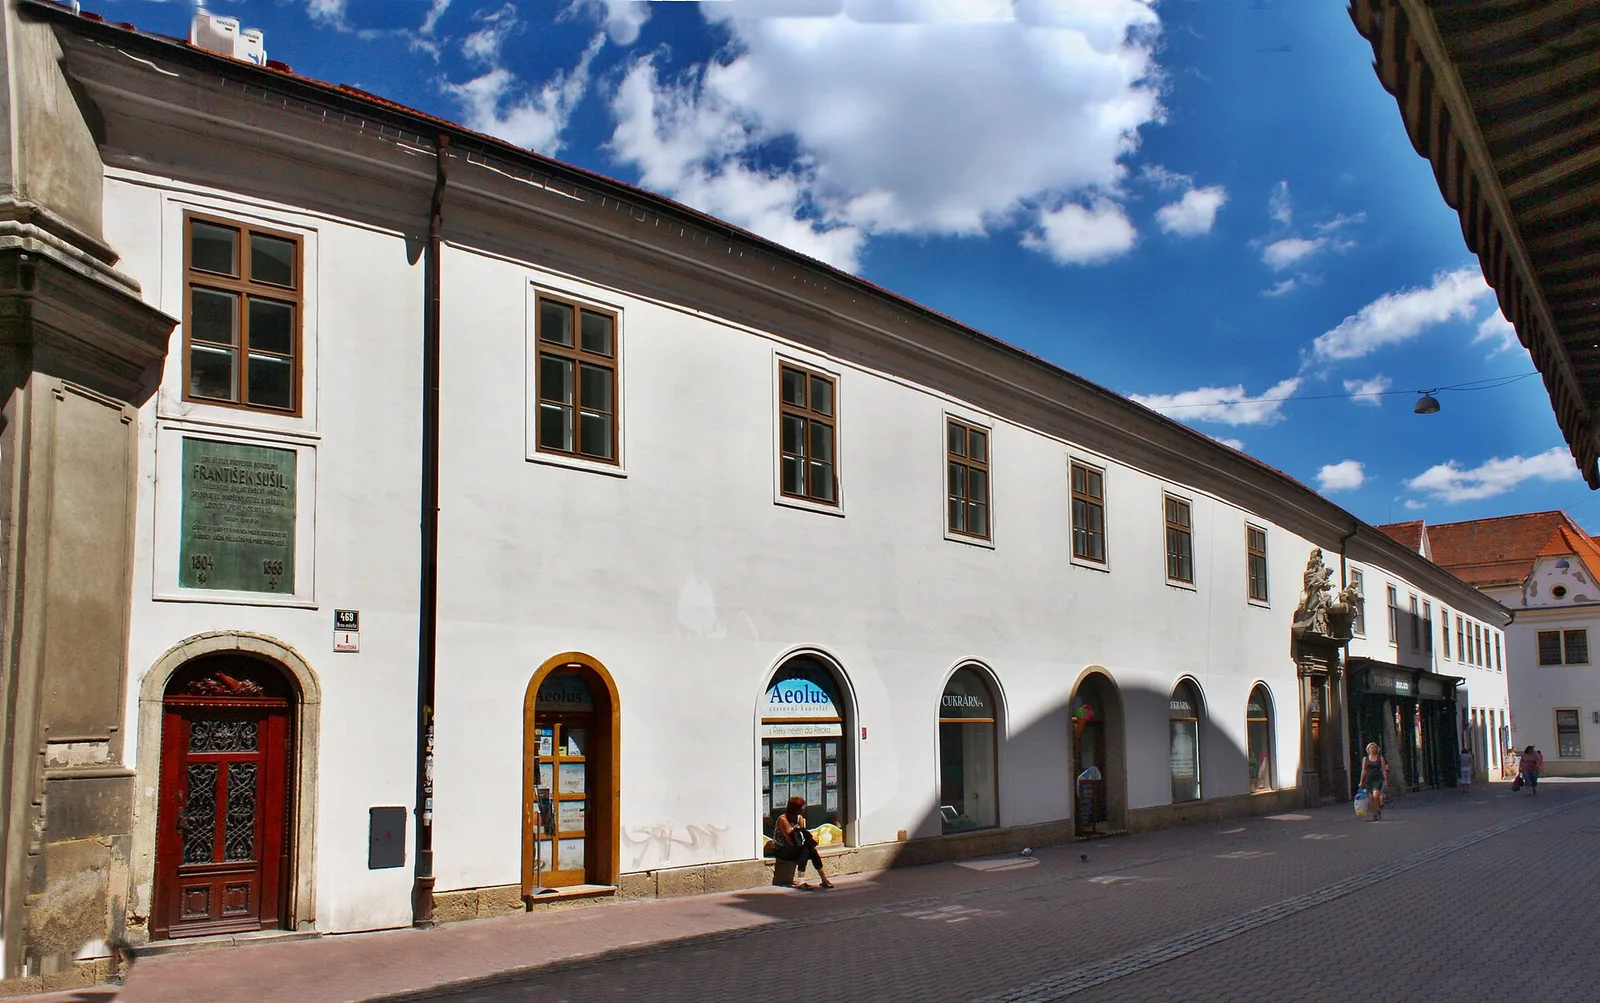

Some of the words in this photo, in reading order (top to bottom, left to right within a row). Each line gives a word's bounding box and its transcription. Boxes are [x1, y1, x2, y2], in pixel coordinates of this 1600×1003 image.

[193, 462, 254, 484] FRANTIŠEK
[256, 469, 288, 489] SUŠIL,
[190, 554, 214, 570] 1804
[262, 559, 283, 575] 1868
[340, 612, 354, 622] 469
[345, 633, 350, 644] 1
[769, 683, 829, 704] Aeolus
[942, 693, 984, 708] CUKRÁRNA
